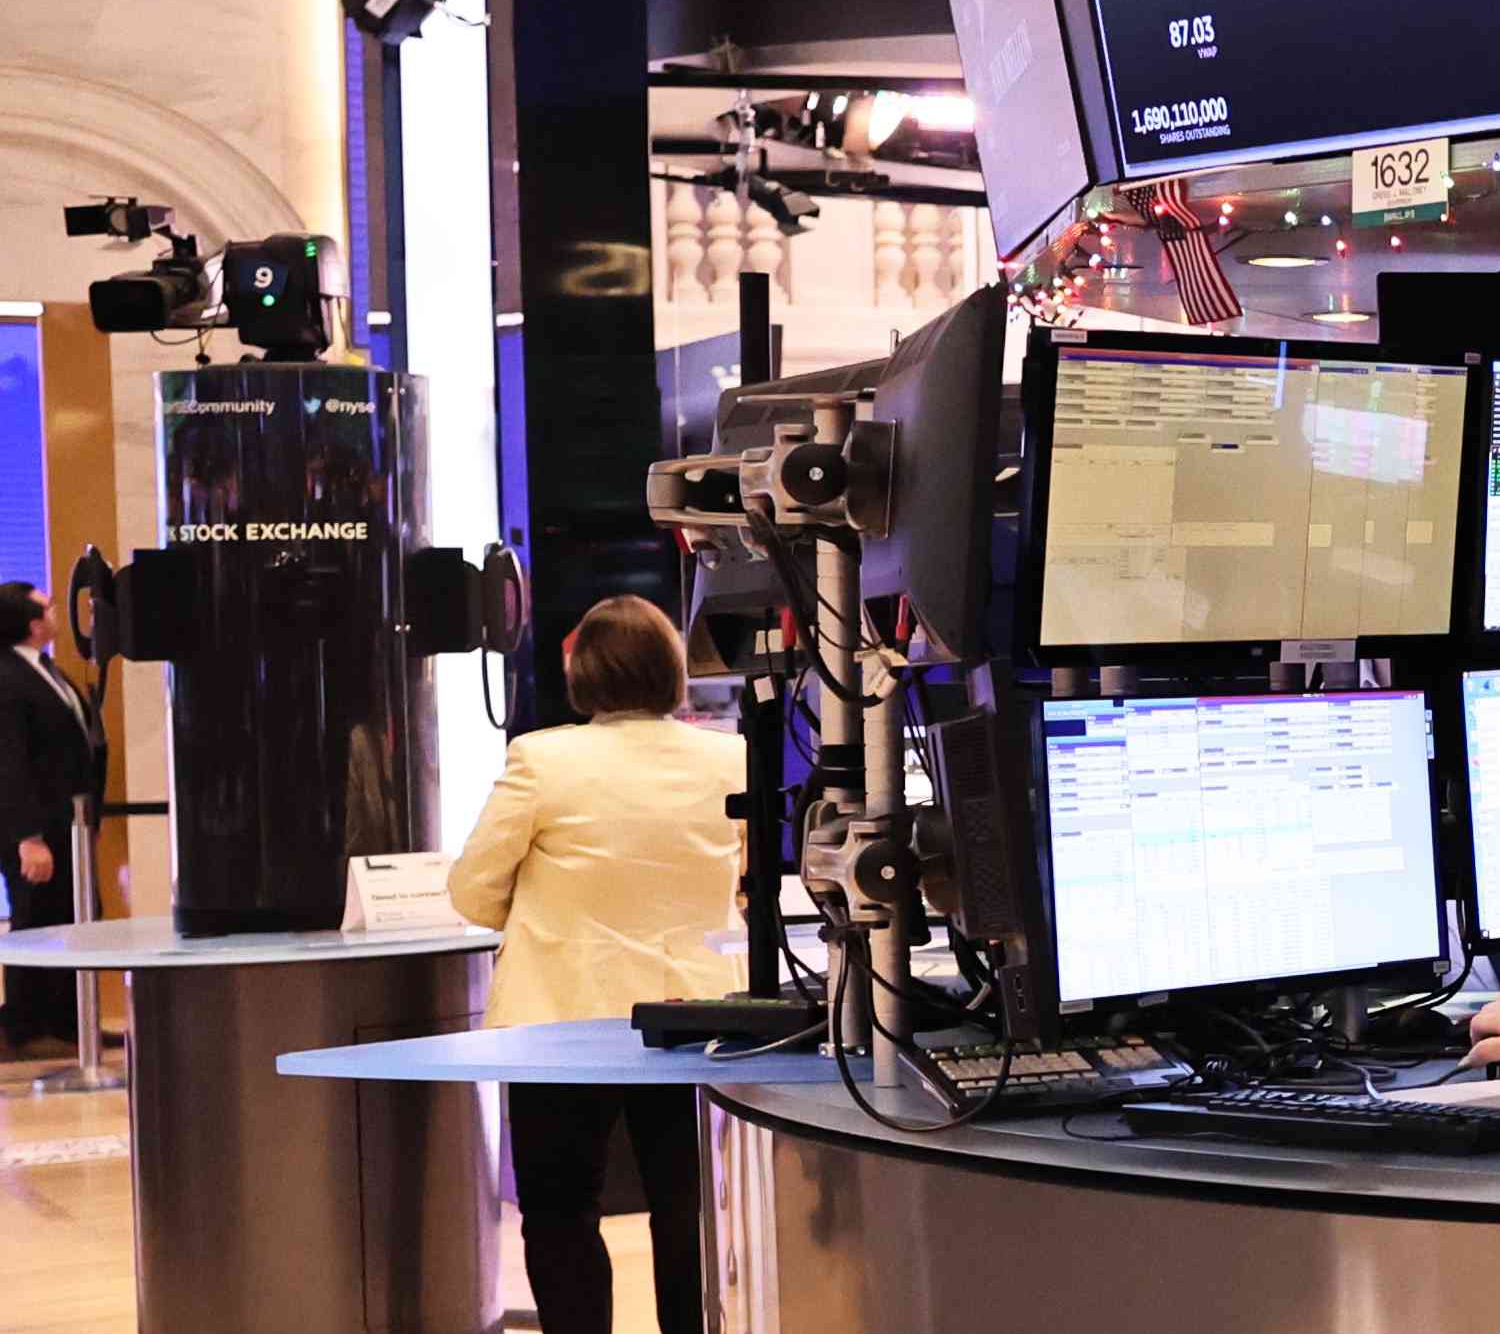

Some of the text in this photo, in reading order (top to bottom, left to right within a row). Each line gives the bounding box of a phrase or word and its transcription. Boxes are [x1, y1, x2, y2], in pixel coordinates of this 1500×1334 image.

[1131, 96, 1228, 134] 1,690,110,000
[1371, 148, 1429, 189] 1632
[254, 267, 274, 288] 9
[180, 522, 368, 541] STOCK EXCHANGE
